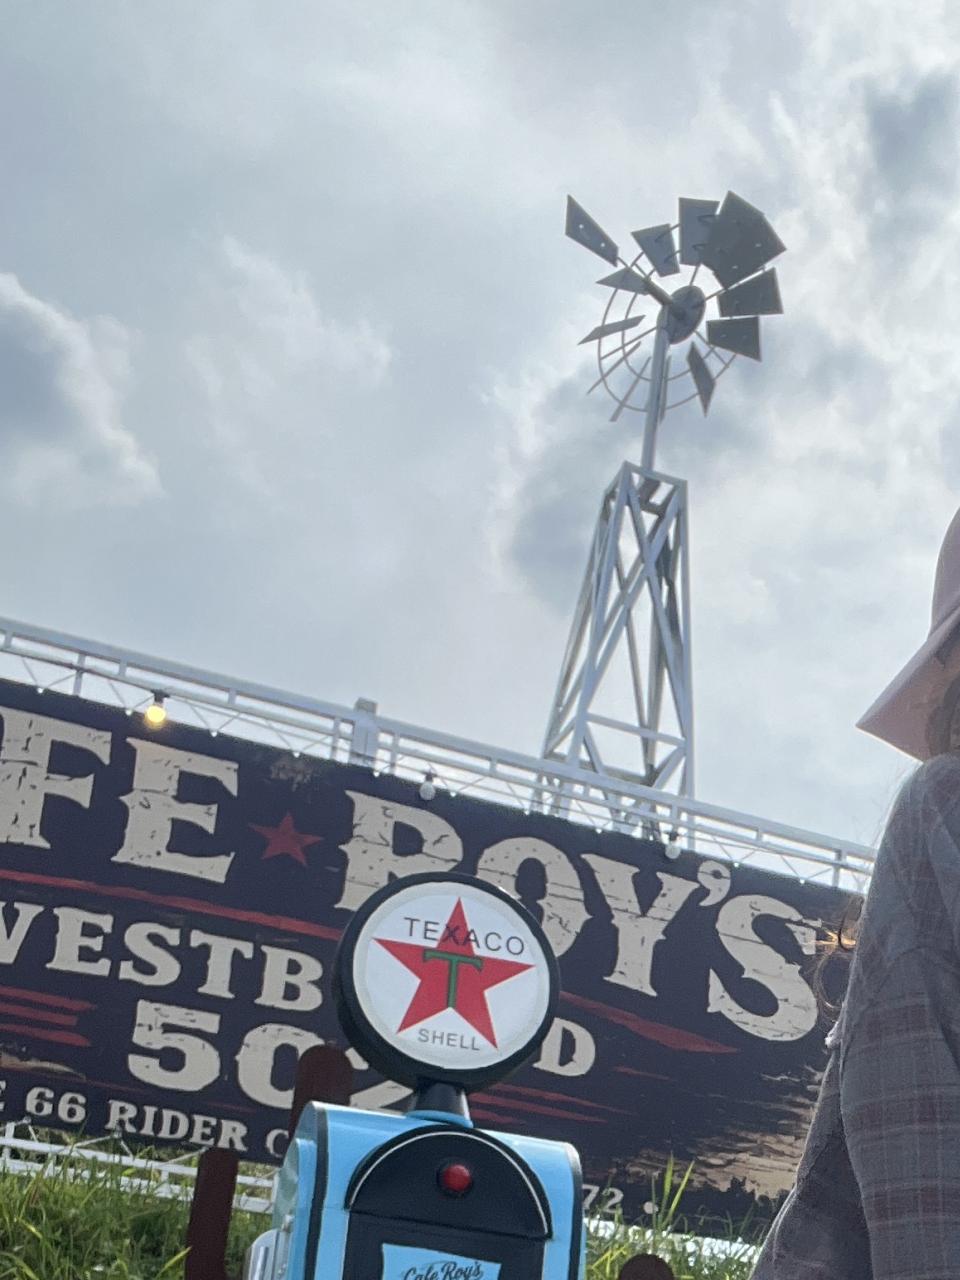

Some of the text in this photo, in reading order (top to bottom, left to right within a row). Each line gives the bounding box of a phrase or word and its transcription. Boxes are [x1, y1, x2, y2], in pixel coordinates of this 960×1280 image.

[334, 790, 819, 1041] ROY'S
[404, 917, 525, 955] TEXACO
[417, 1028, 480, 1050] SHELL
[25, 1086, 87, 1123] 66
[104, 1099, 248, 1151] RIDER
